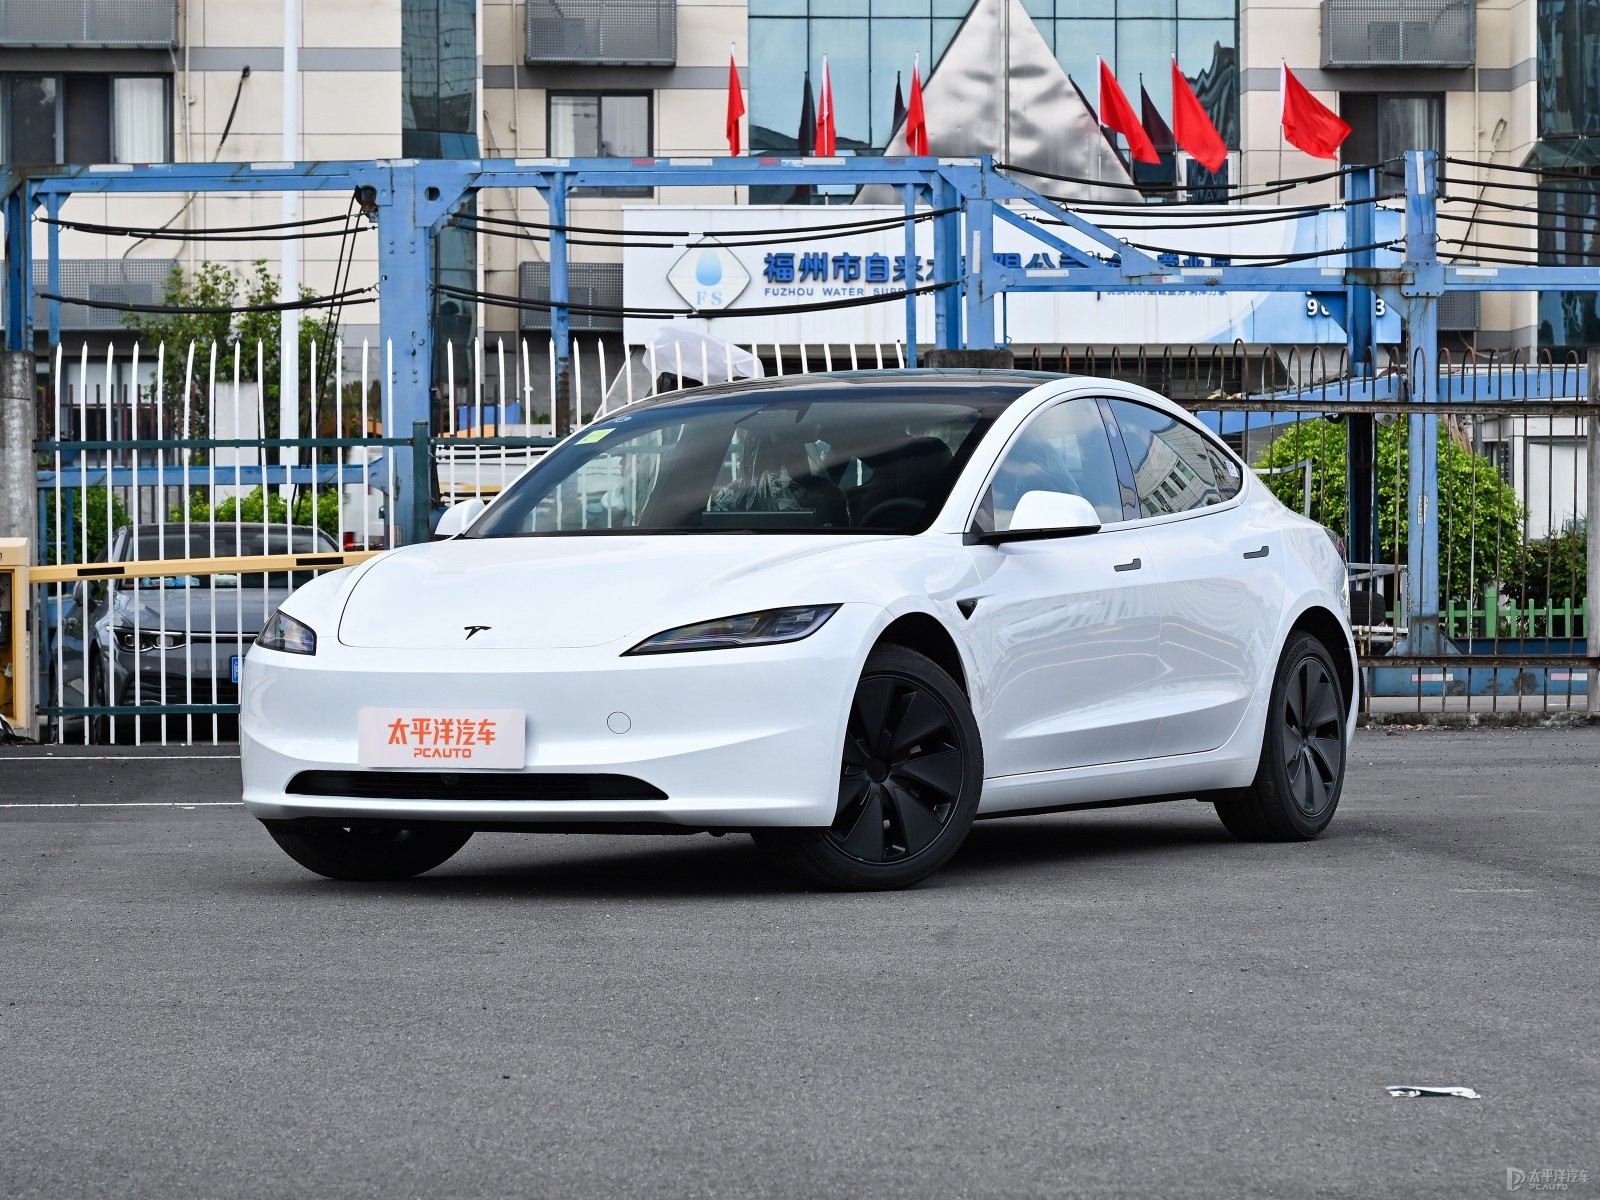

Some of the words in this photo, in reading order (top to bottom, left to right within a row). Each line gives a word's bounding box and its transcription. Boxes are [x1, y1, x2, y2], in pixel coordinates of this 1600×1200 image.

[696, 290, 722, 306] FS
[764, 287, 814, 297] FUZHOU
[822, 287, 865, 297] WATER
[387, 717, 497, 746] 太平洋汽车
[413, 747, 472, 759] PCAUTO
